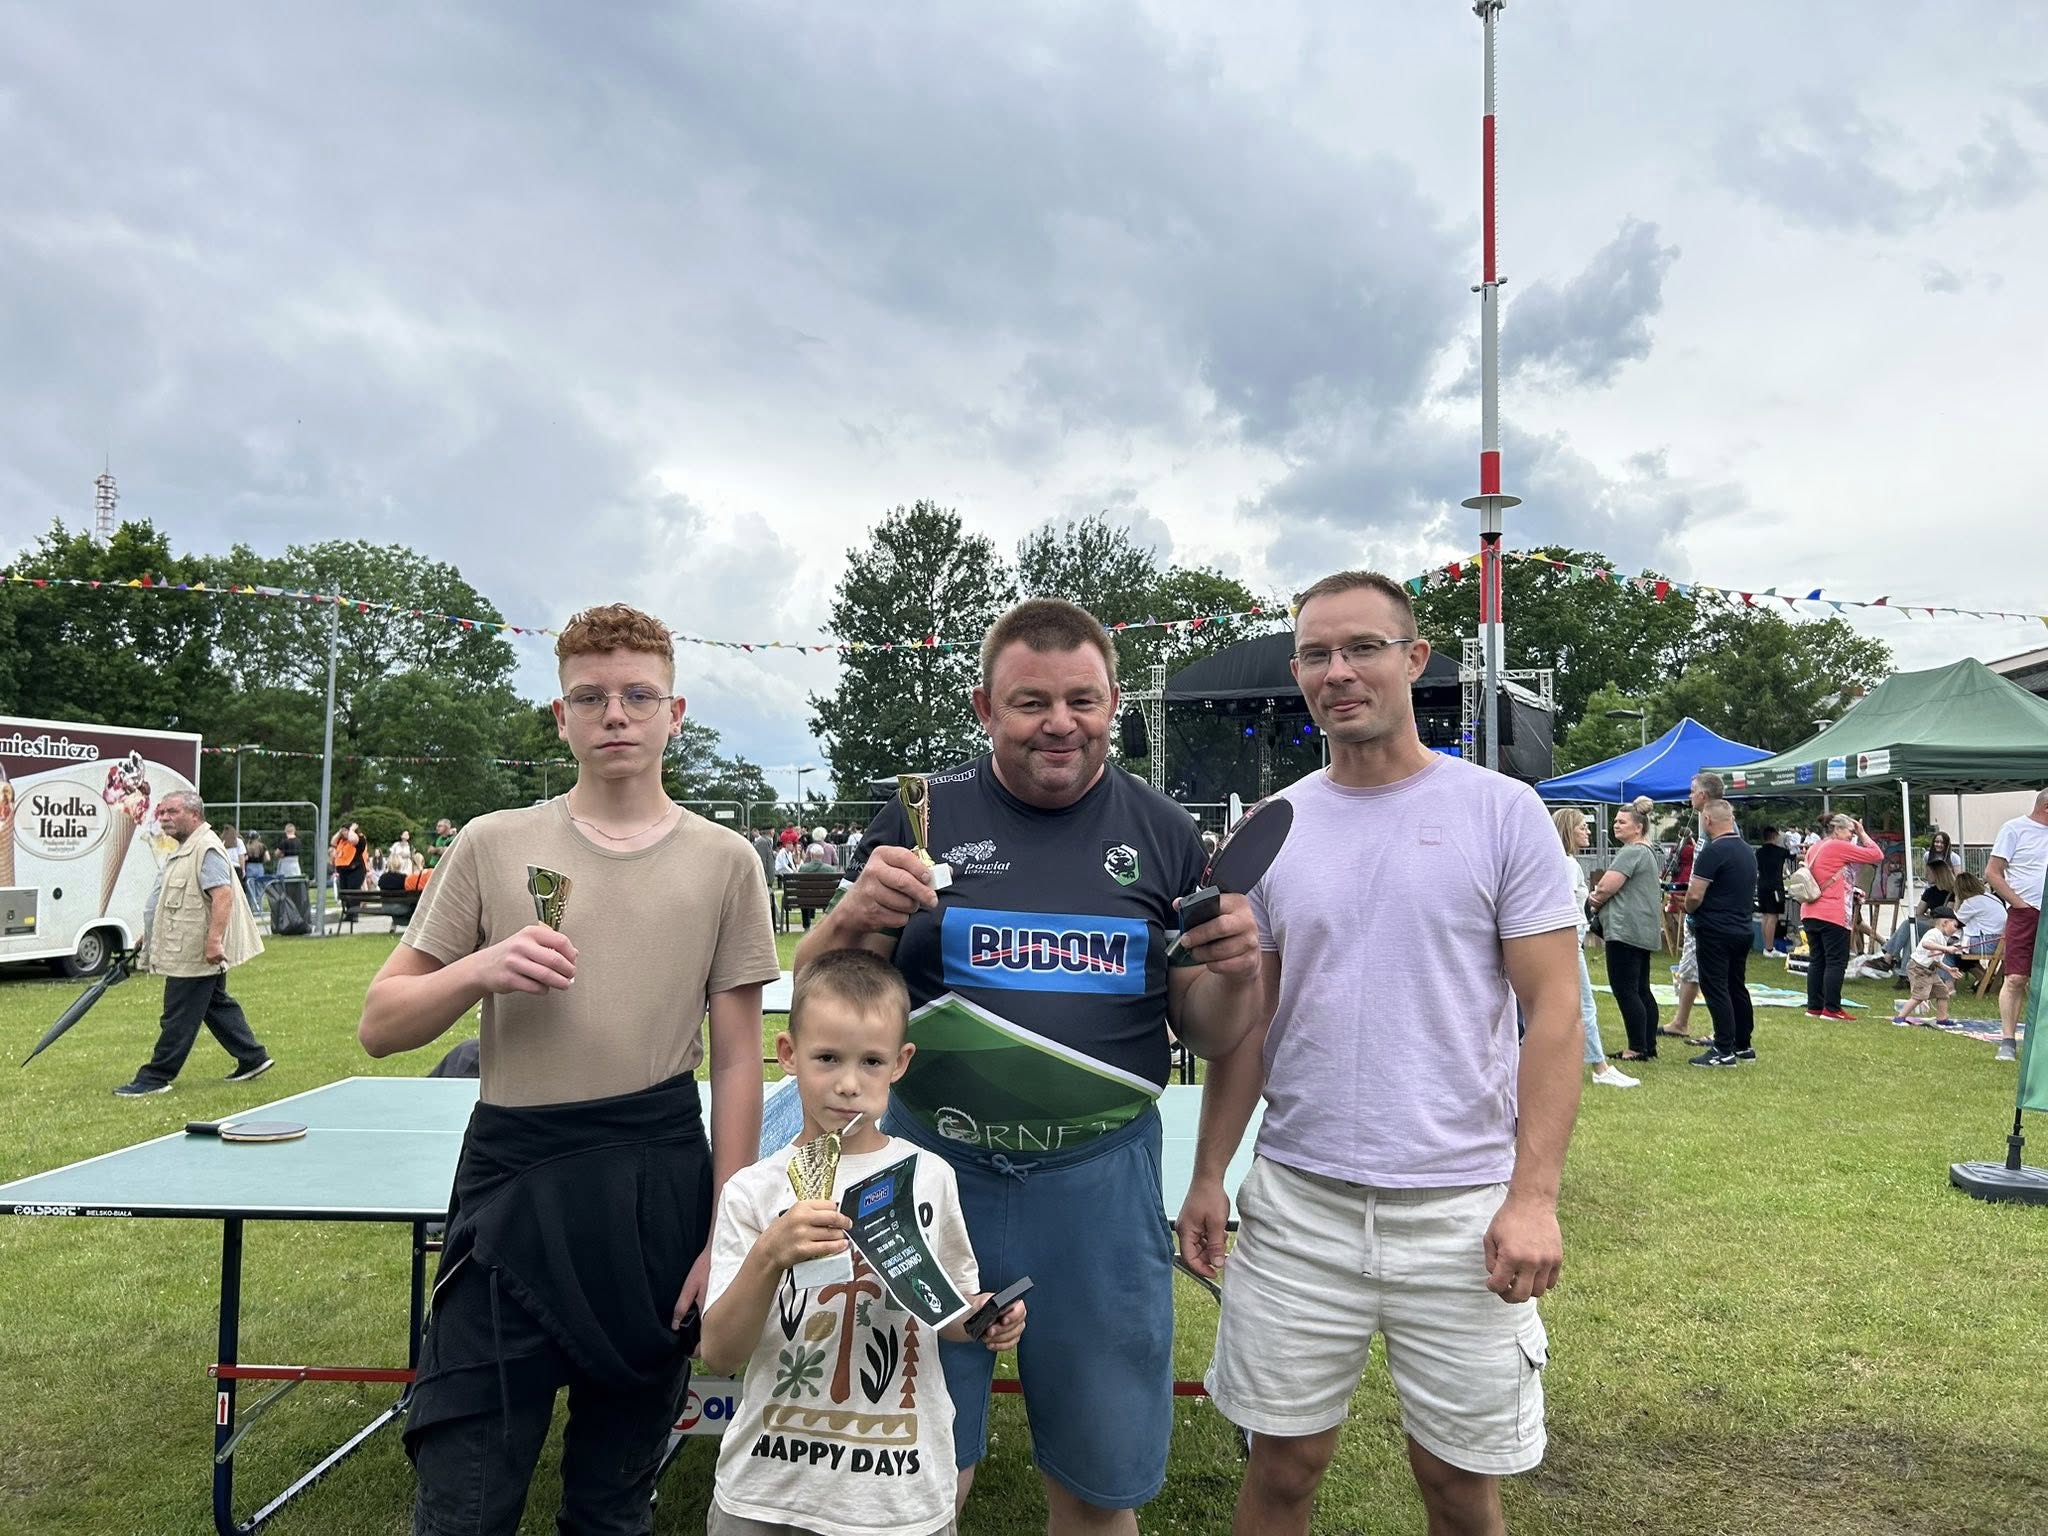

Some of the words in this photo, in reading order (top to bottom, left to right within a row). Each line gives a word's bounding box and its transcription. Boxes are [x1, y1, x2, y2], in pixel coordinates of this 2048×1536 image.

[31, 795, 97, 816] Słodka
[39, 818, 88, 838] Italia
[964, 861, 1011, 874] powiat
[971, 924, 1128, 975] BUDOM
[751, 1433, 846, 1470] HAPPY
[851, 1449, 920, 1476] DAYS
